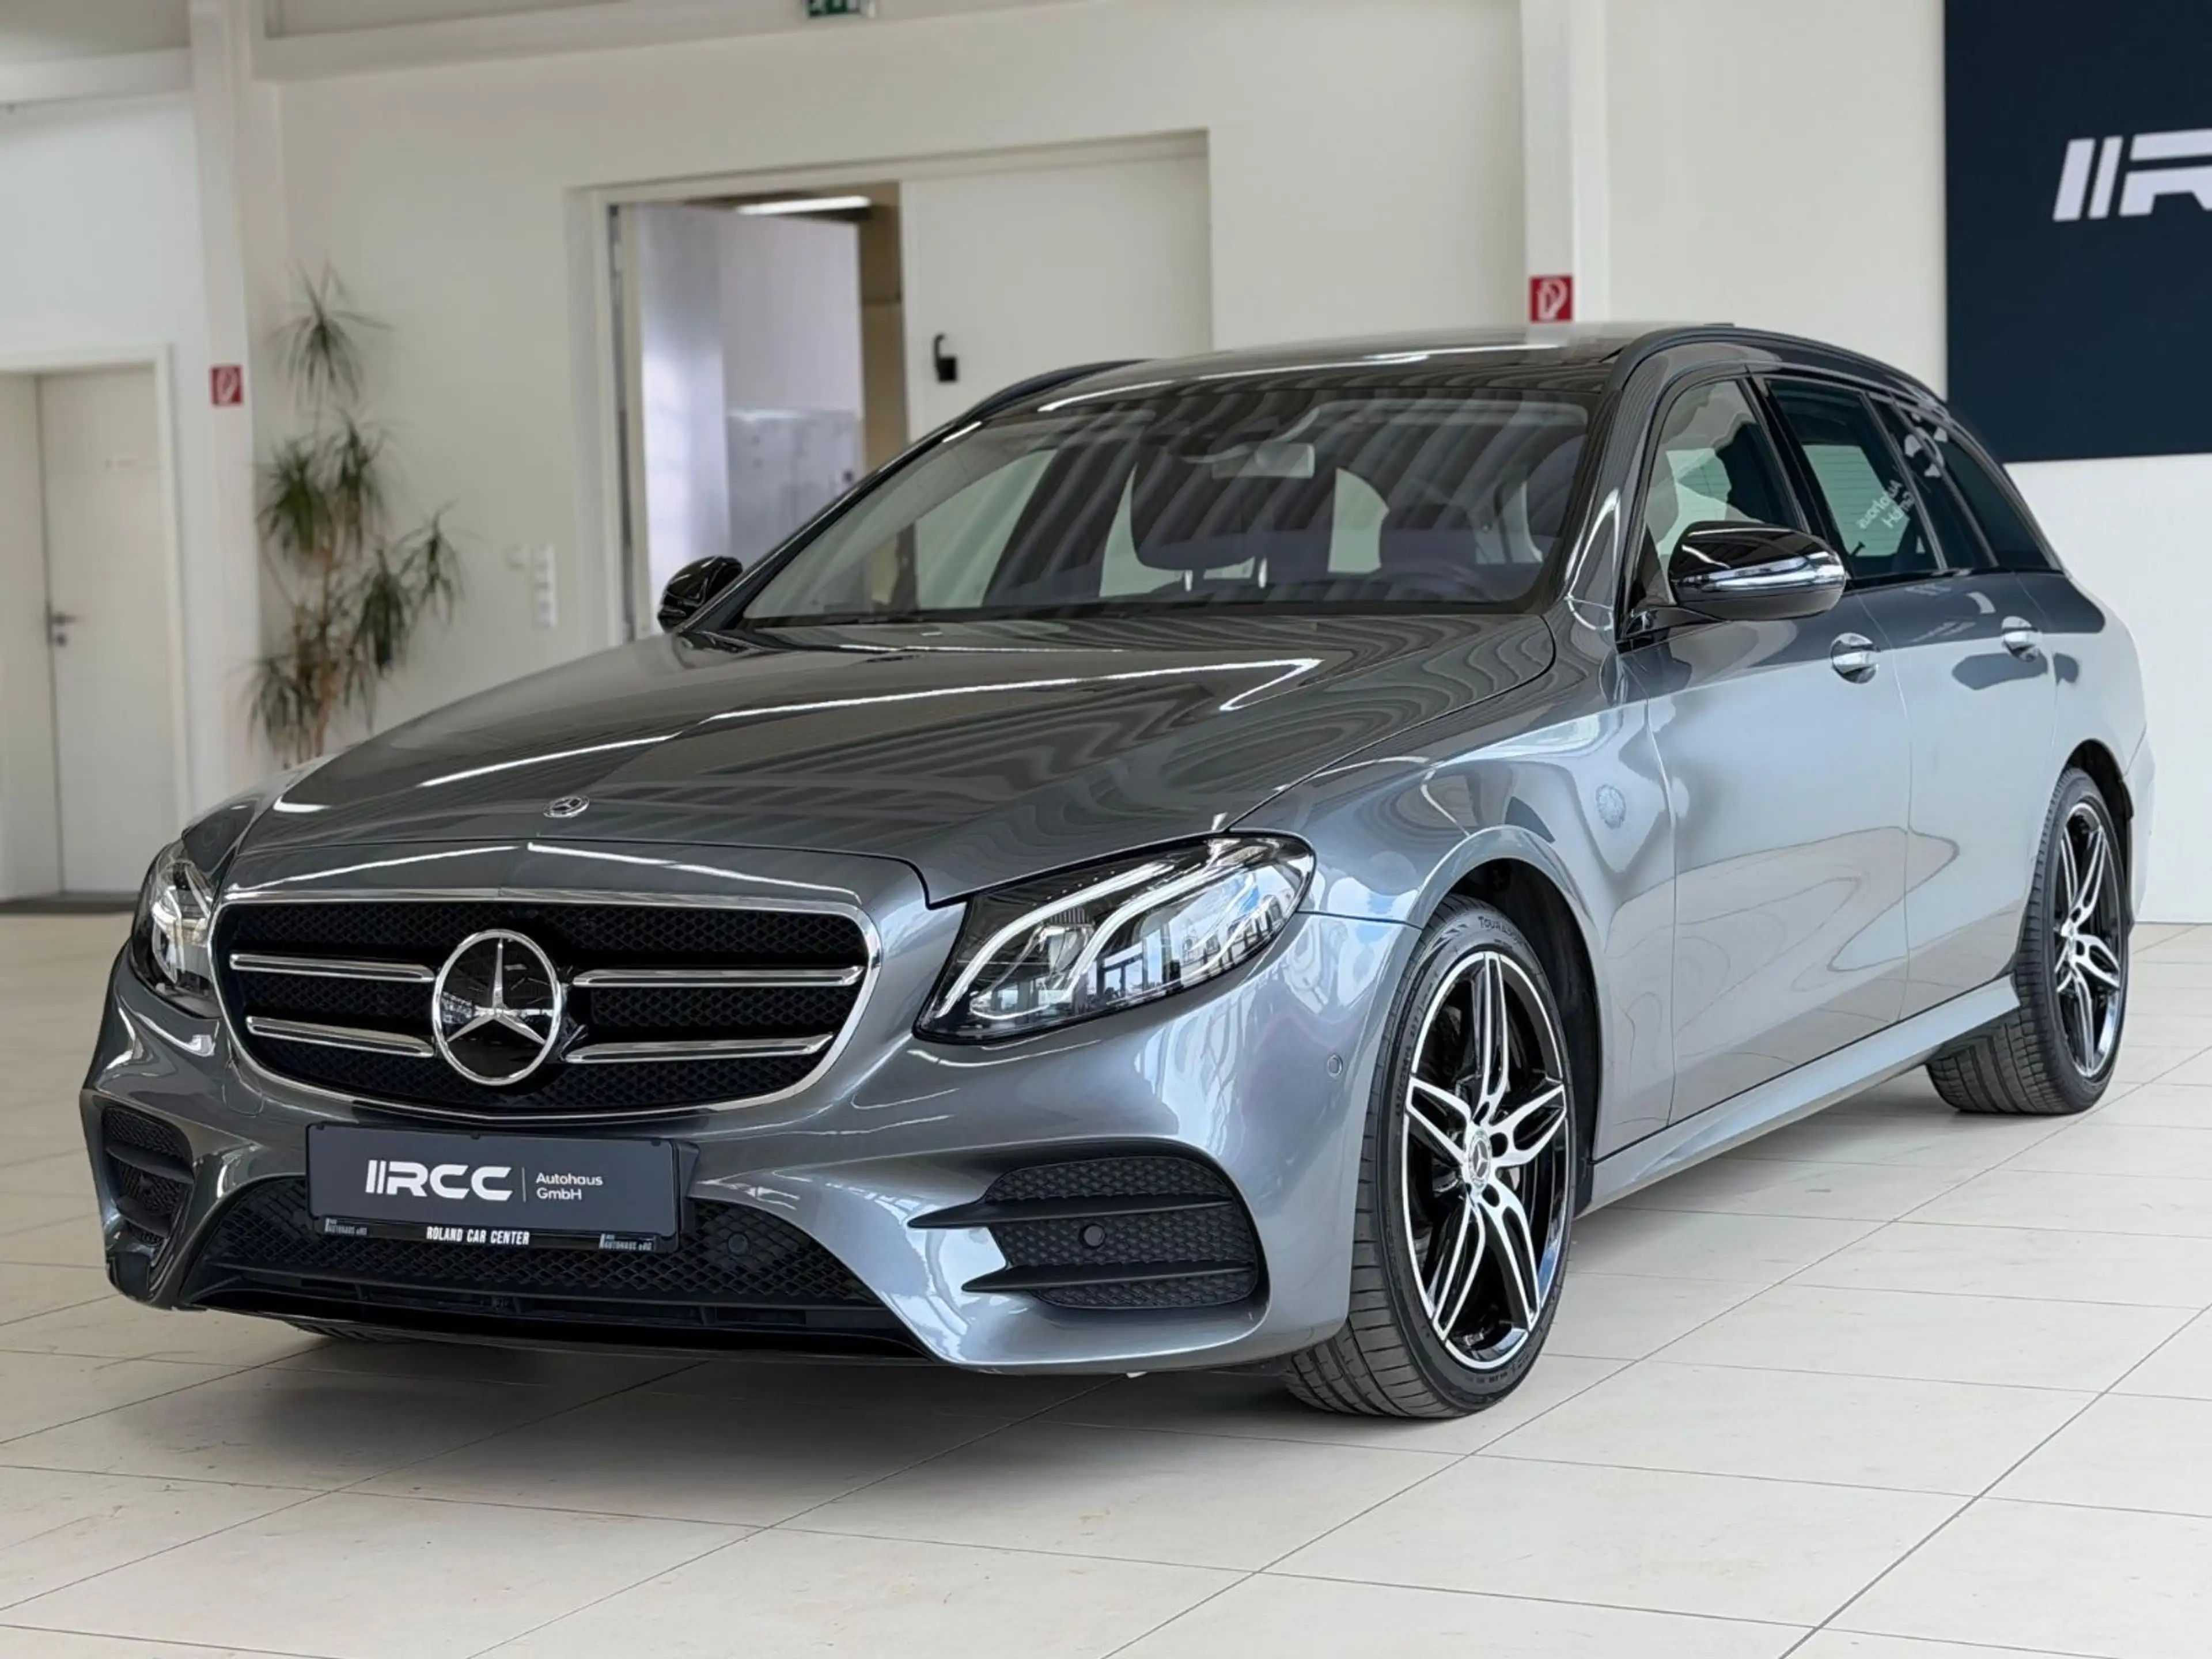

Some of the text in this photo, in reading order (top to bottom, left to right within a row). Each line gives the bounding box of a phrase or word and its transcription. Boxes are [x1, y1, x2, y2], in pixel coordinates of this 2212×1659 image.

[536, 1172, 604, 1186] Autohaus
[536, 1187, 582, 1200] GmbH
[426, 1226, 530, 1245] ROLAND CAR CENTER
